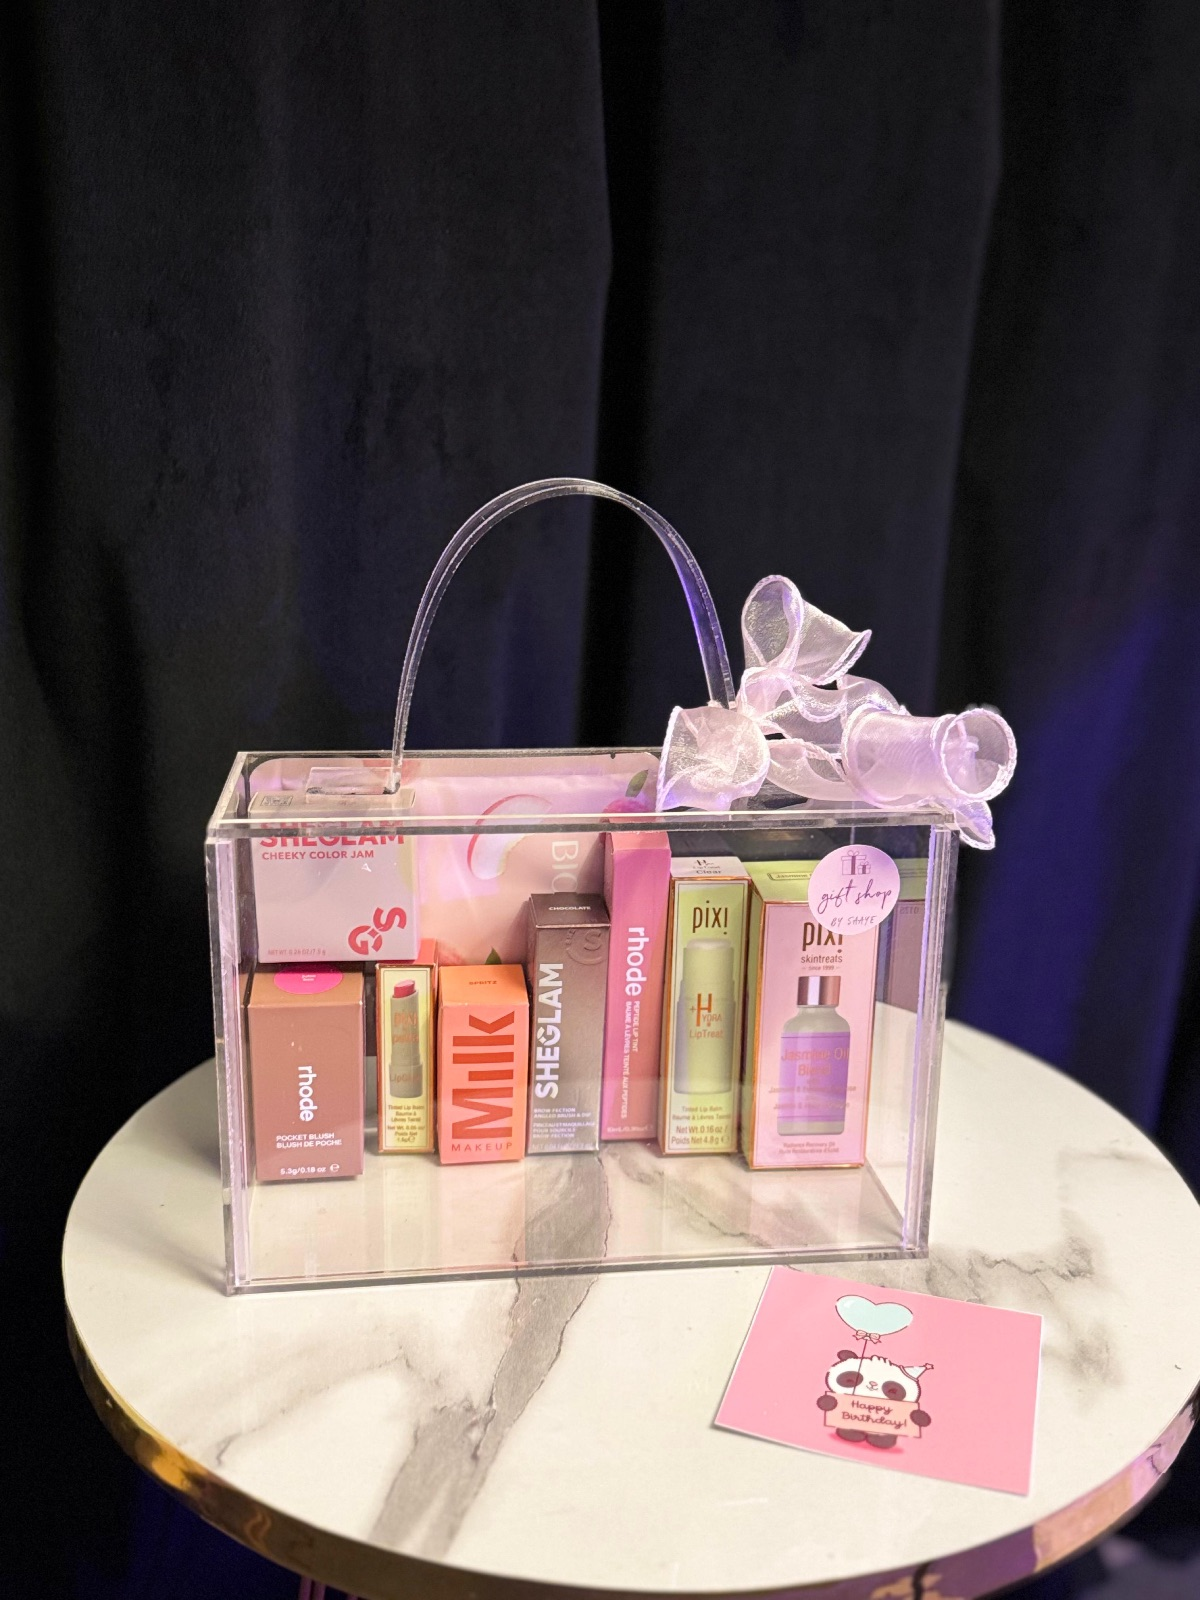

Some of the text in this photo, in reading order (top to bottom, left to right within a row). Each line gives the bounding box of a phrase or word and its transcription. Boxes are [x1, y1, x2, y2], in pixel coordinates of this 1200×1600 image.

[262, 850, 375, 860] CHEEKY COLOR JAM
[817, 878, 892, 914] gift shop
[830, 915, 877, 927] BY SAAYE
[625, 926, 649, 996] rhode
[800, 954, 843, 964] skintreats
[624, 1001, 632, 1023] BAUME
[633, 1001, 641, 1027] PEPTIDE
[535, 963, 564, 1099] SHEGLAM
[834, 1047, 850, 1059] Oil
[451, 1010, 515, 1139] Milk
[298, 1065, 317, 1122] rhode
[676, 1125, 688, 1133] Net
[276, 1132, 335, 1141] POCKET BLUSH
[276, 1141, 303, 1149] BLUSH
[315, 1139, 342, 1147] POCHE
[451, 1142, 513, 1151] MAKEUP
[280, 1166, 316, 1175] 5.3g/0.18
[851, 1400, 893, 1415] Happy
[841, 1411, 908, 1429] Birthday!
